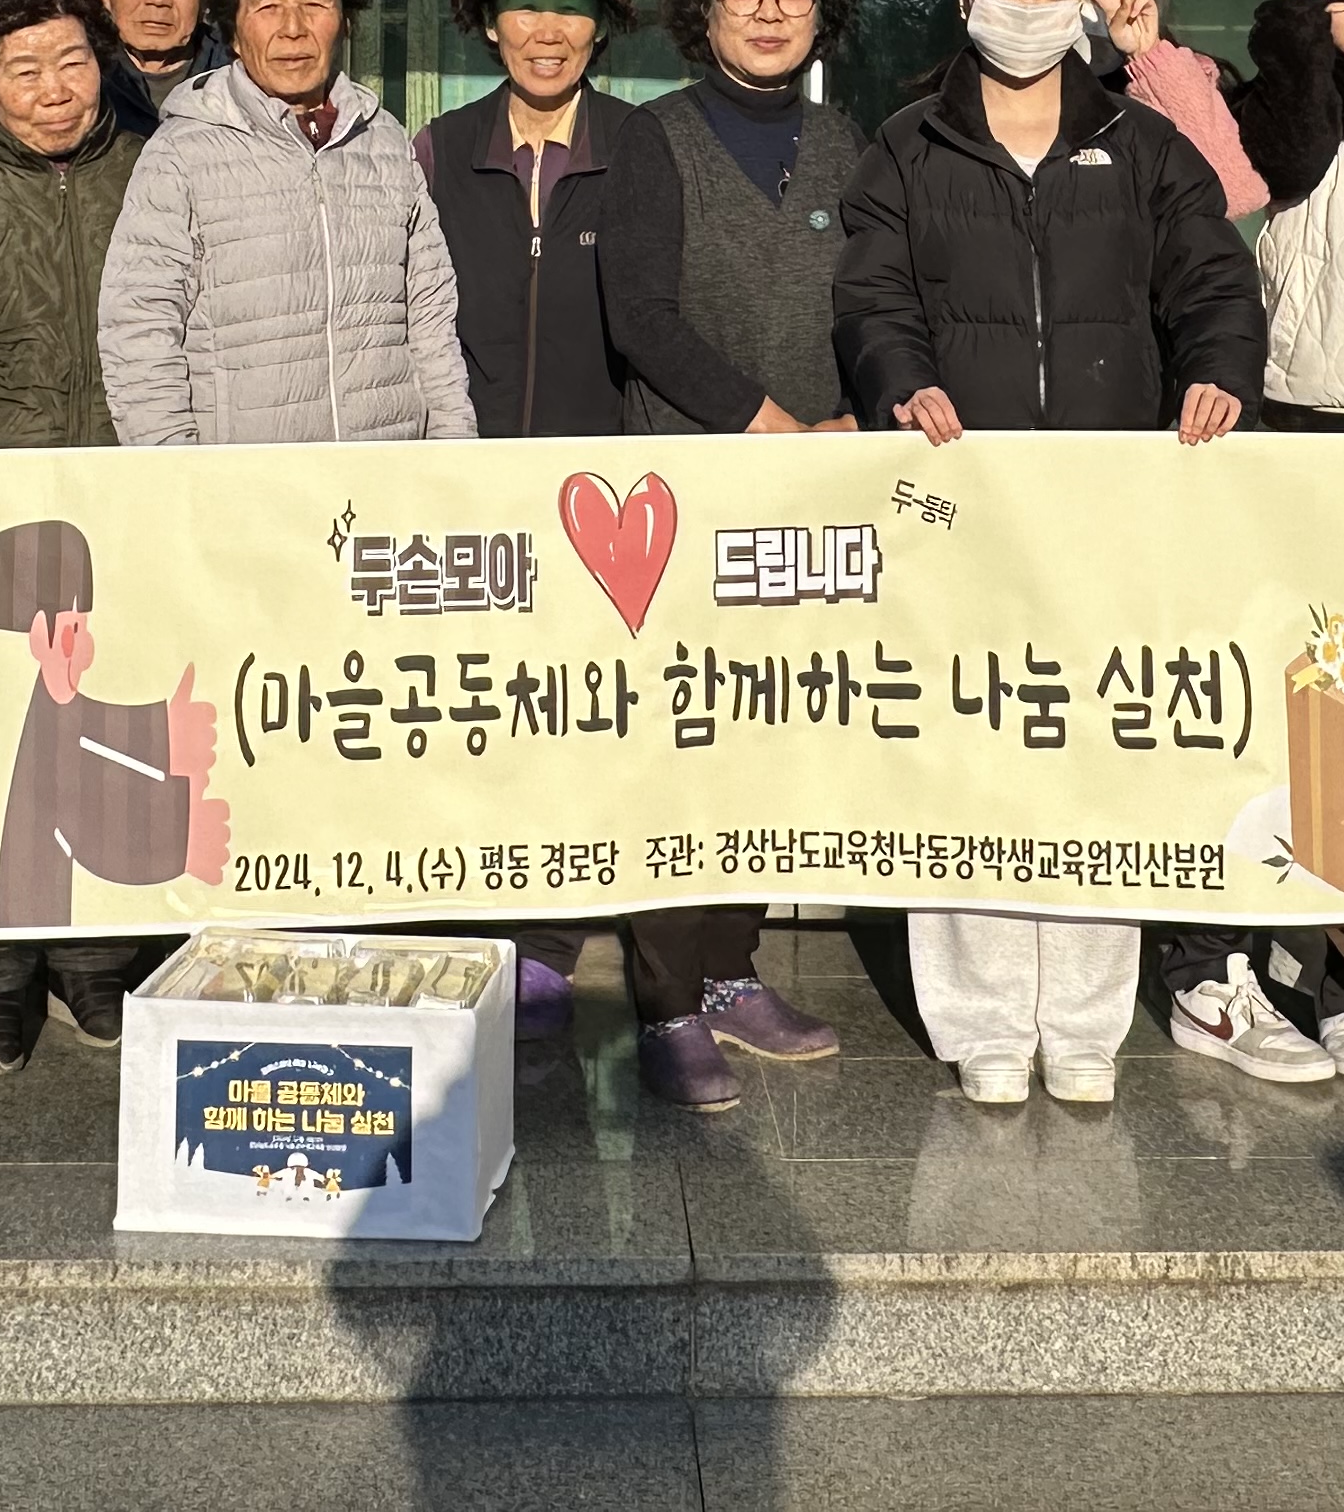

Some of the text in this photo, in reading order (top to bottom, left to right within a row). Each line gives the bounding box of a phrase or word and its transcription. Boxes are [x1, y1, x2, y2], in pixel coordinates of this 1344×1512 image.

[350, 522, 884, 617] 두손모아 드립니다
[233, 638, 1253, 768] (마을공동체와 함께하는 나눔 실천)
[478, 843, 531, 891] 평동
[540, 839, 621, 890] 경로당
[644, 831, 705, 879] 주관:
[716, 827, 1226, 892] 경상남도교육청낙동강학생교육원진산분원
[202, 1106, 395, 1136] 함께 하는 나눔 실천
[227, 1079, 366, 1107] 마을 공동체와
